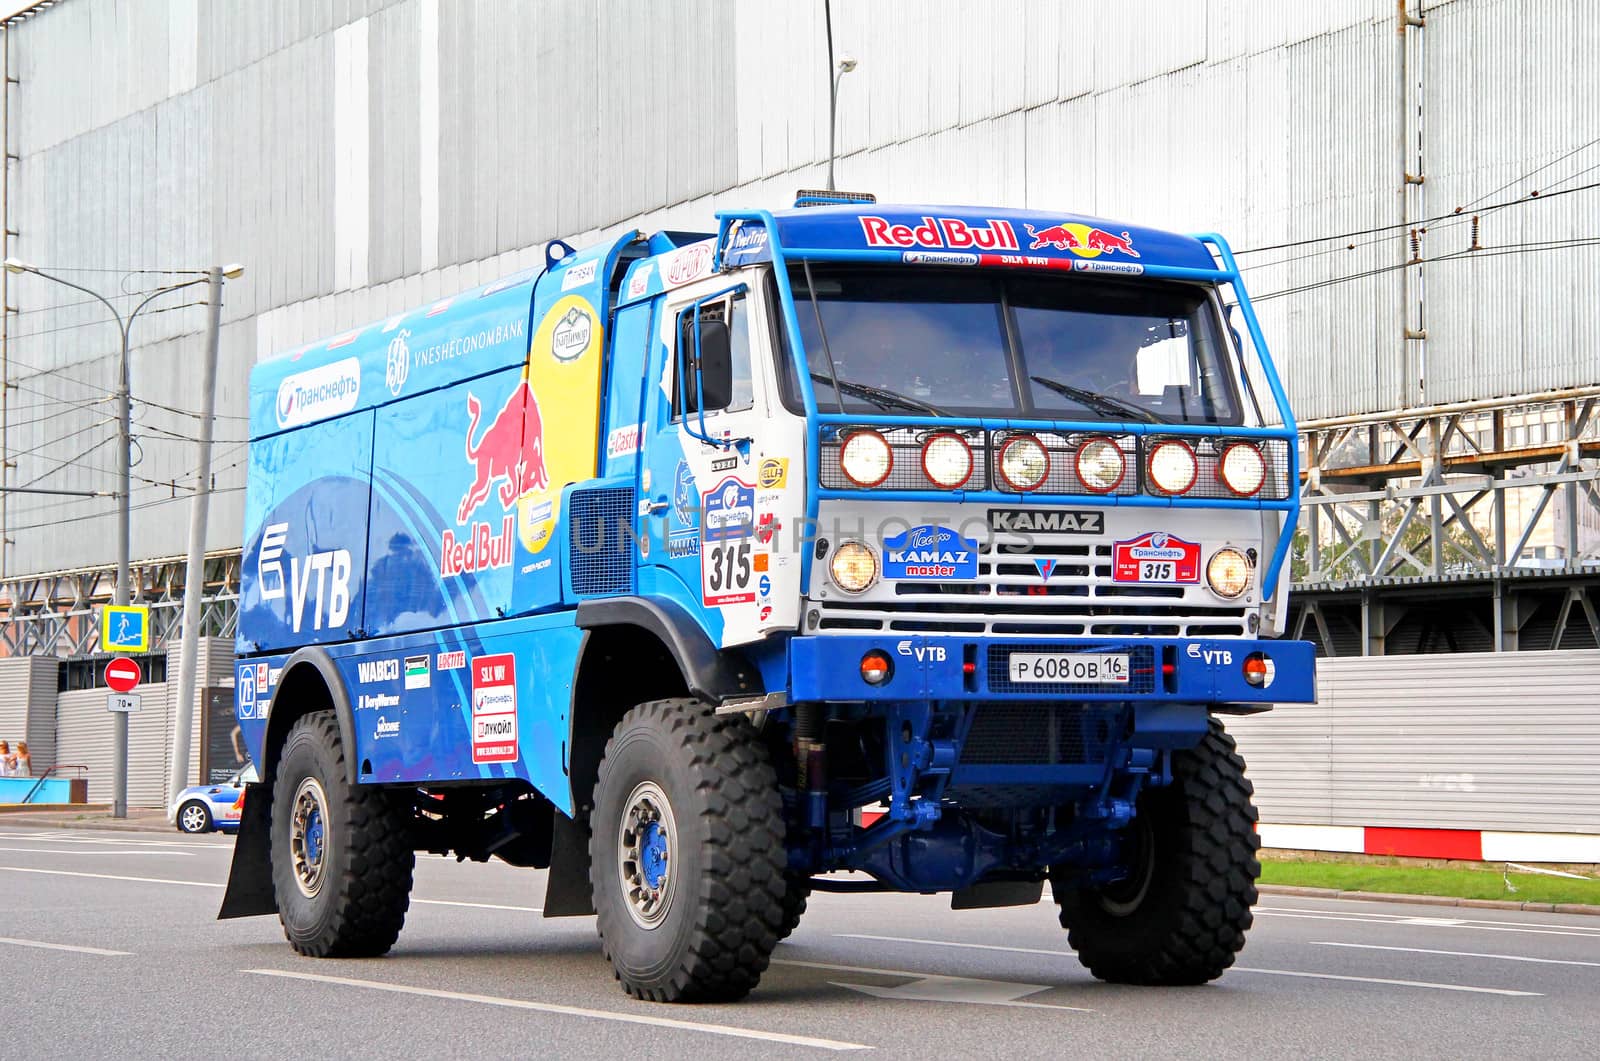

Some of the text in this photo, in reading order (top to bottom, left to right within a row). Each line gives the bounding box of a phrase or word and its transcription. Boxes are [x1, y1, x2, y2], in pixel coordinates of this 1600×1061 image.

[859, 216, 1020, 250] Red Bull
[919, 254, 976, 265] Транснефть
[1091, 263, 1142, 274] Транснефть
[414, 319, 523, 368] VNESHECONOMBANK
[295, 374, 357, 407] Транснефть
[992, 511, 1100, 531] KAMAZ
[441, 514, 514, 578] Red Bull
[911, 528, 951, 549] Team
[669, 537, 700, 559] KAMAZ
[1134, 548, 1183, 558] Транснефть
[888, 551, 969, 564] KAMAZ
[709, 544, 751, 591] 315
[906, 564, 956, 577] master
[1144, 563, 1171, 579] 315
[290, 549, 351, 633] VTB
[438, 652, 465, 669] LOCTITE
[914, 647, 946, 662] VTB
[1203, 650, 1233, 665] VTB
[358, 659, 399, 684] WABCO
[1104, 657, 1122, 673] 16
[481, 666, 494, 683] SILK
[484, 720, 512, 735] ЛУКОЙЛ
